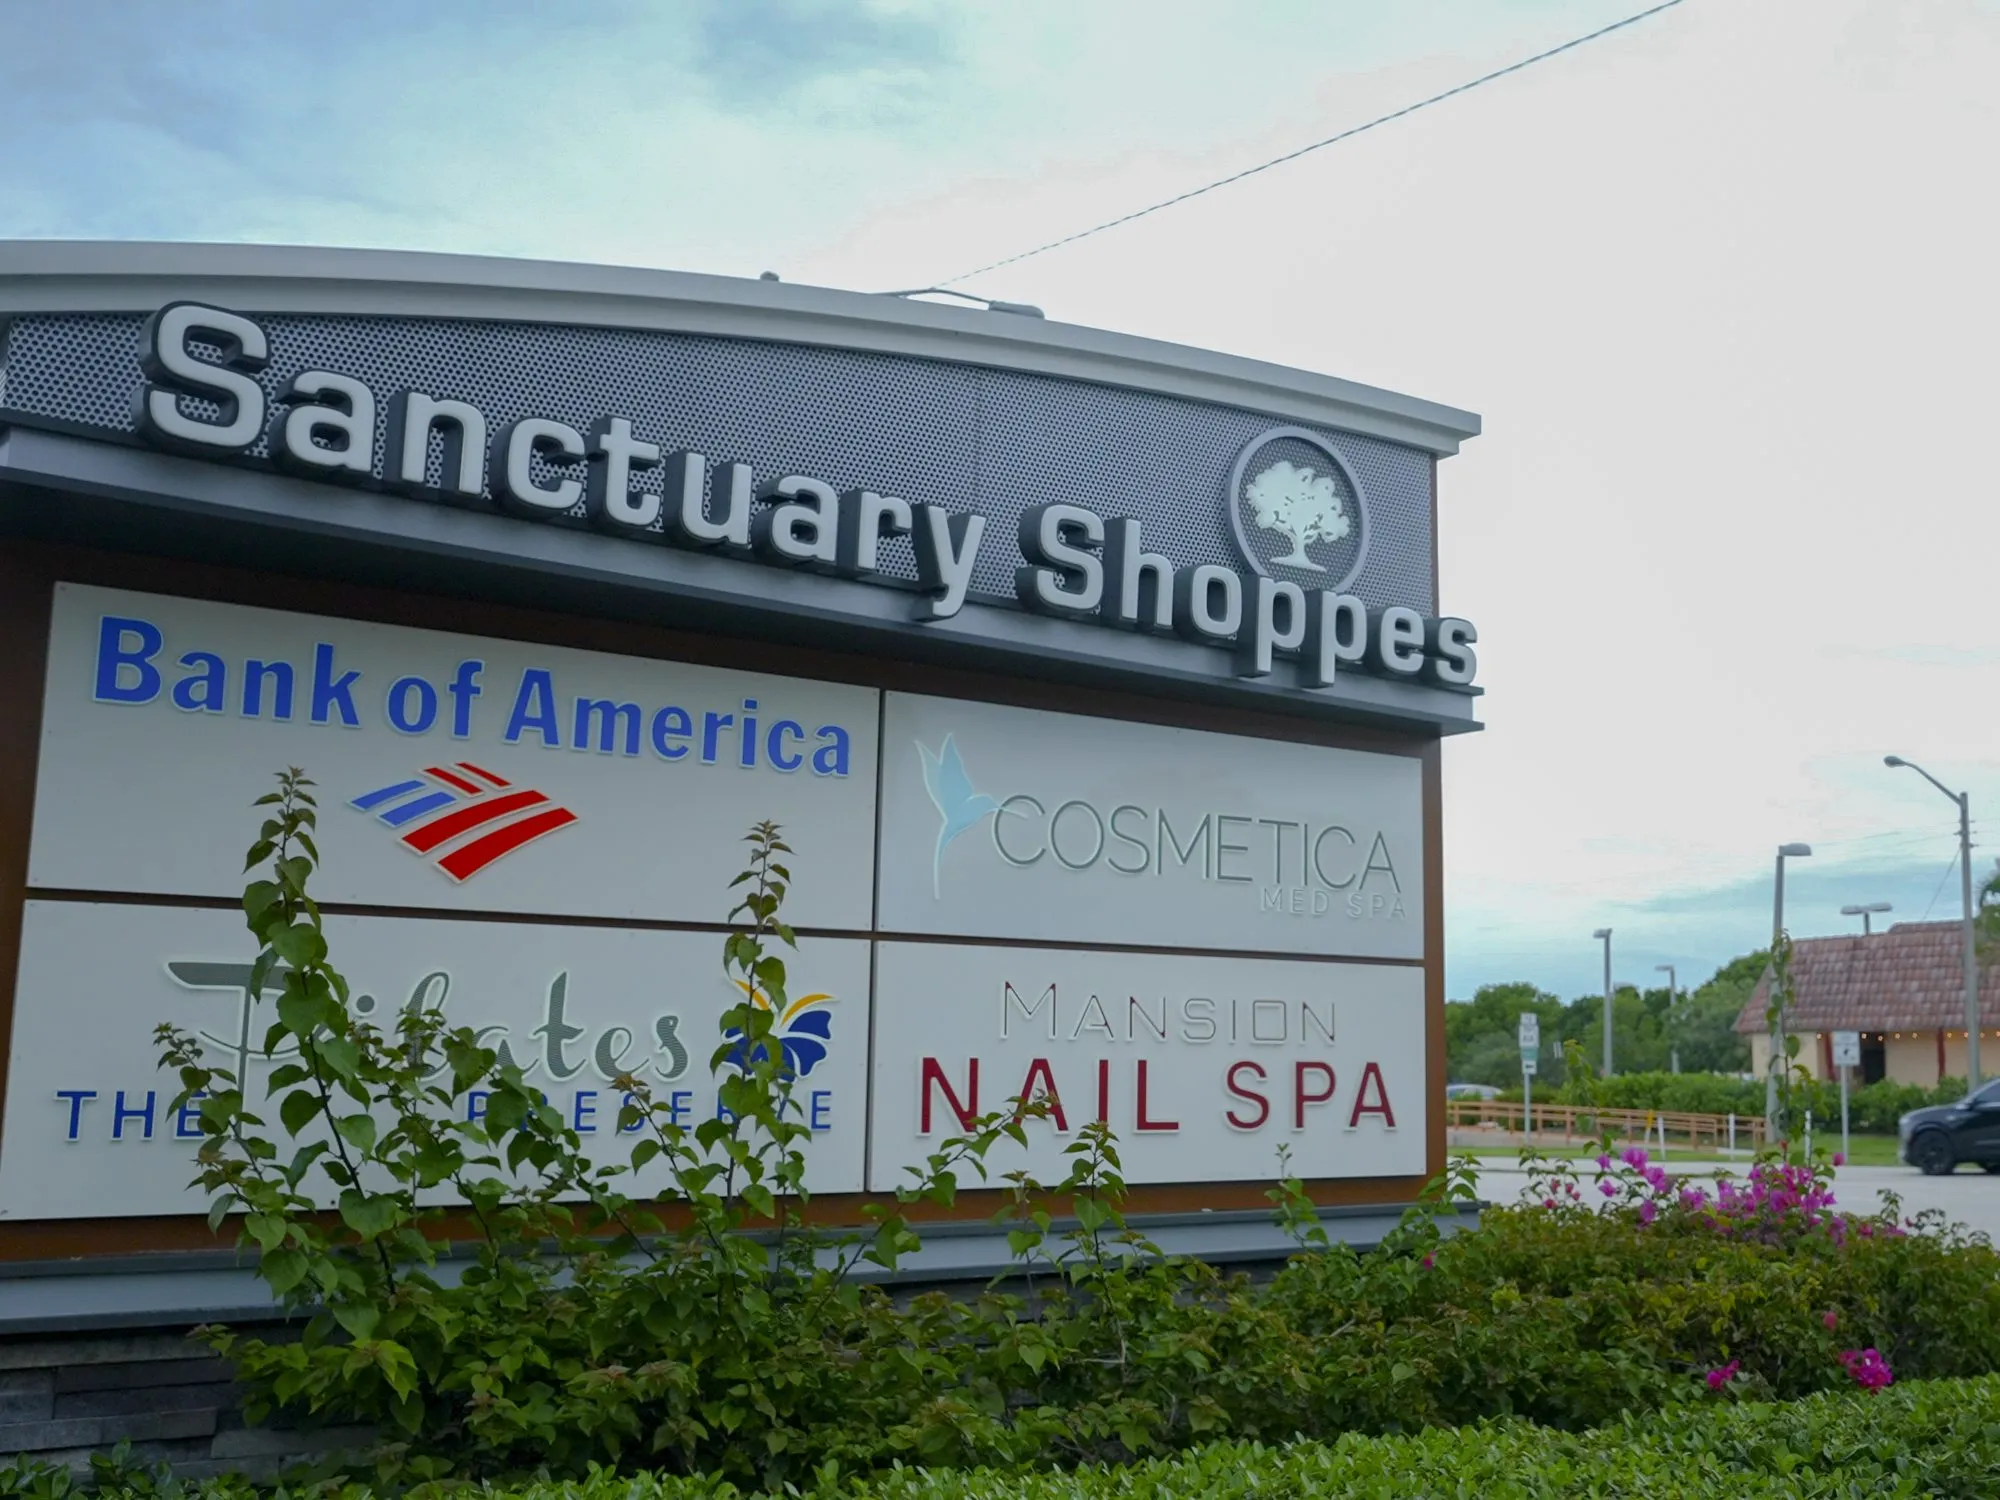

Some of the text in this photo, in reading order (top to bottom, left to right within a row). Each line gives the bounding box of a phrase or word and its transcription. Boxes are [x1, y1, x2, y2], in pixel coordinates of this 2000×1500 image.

[138, 303, 1477, 687] Sanctuary Shoppes
[95, 614, 852, 777] Bank of America
[992, 794, 1402, 893] COSMETICA
[1260, 886, 1407, 920] MED SPA
[1000, 980, 1338, 1044] MANSION
[55, 1090, 209, 1140] THE
[915, 1055, 1398, 1136] NAIL SPA
